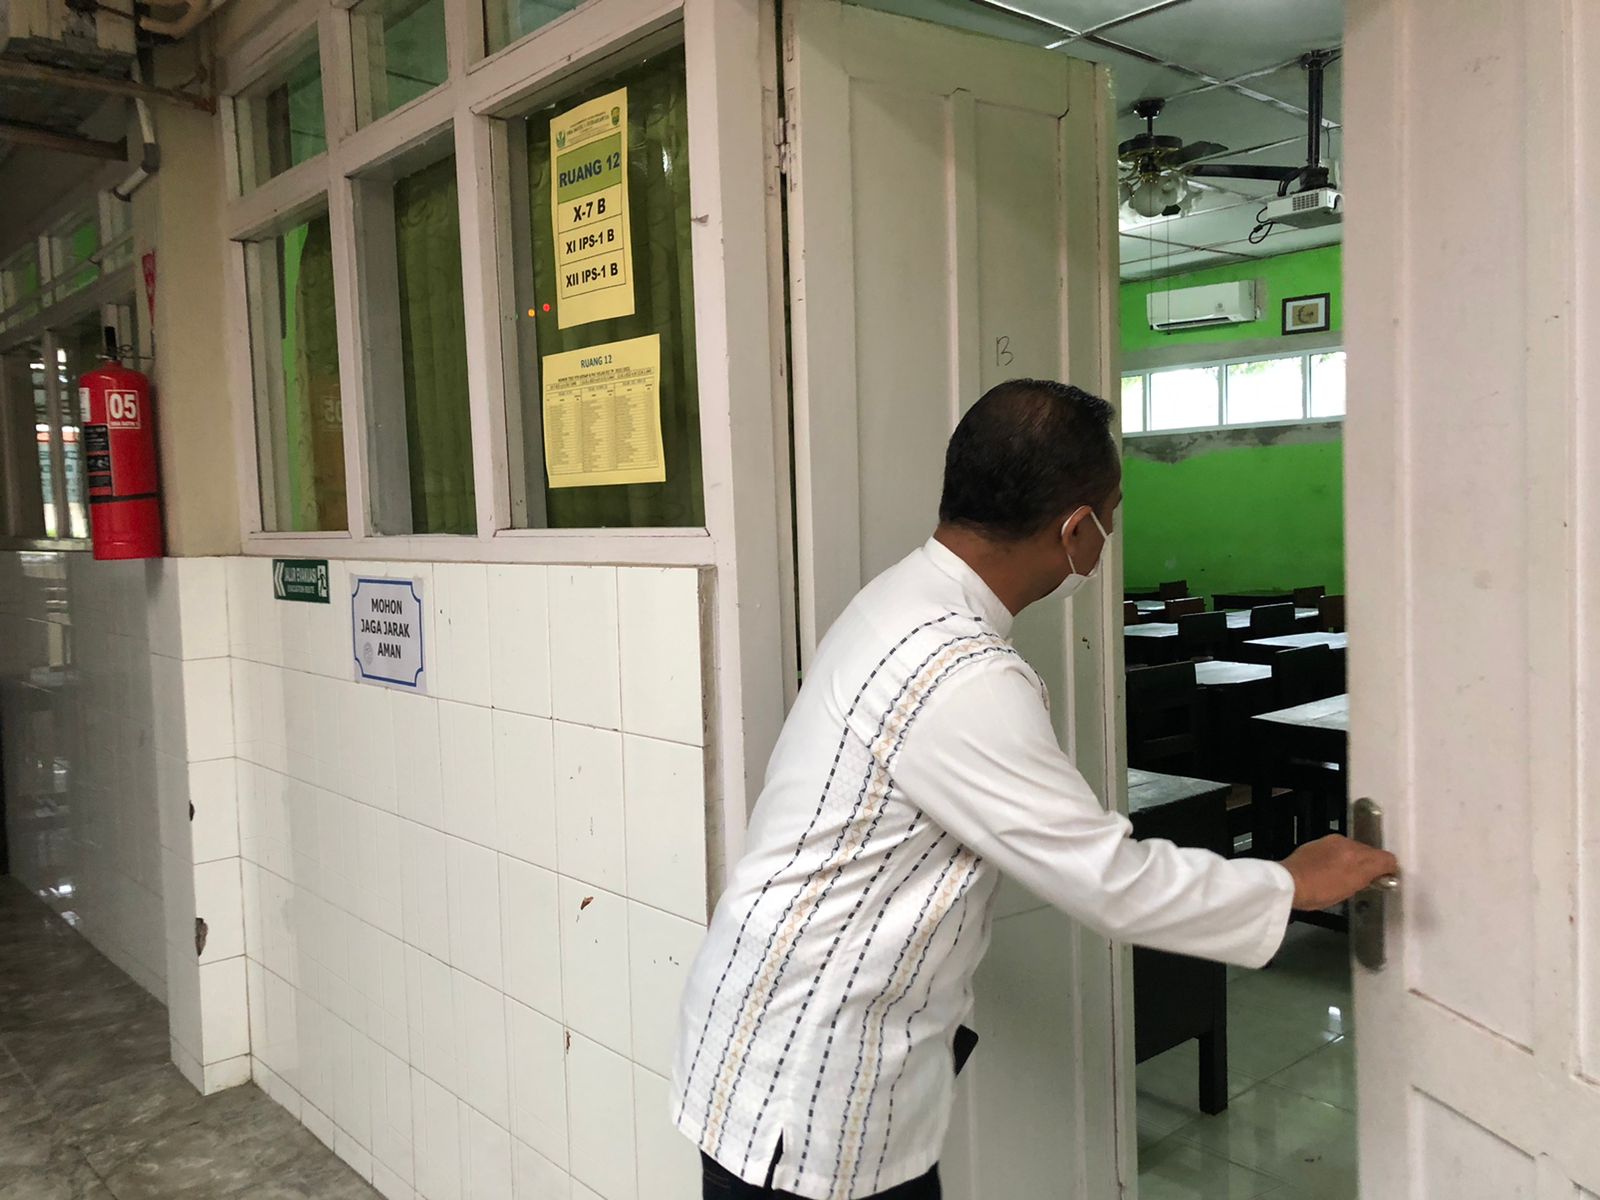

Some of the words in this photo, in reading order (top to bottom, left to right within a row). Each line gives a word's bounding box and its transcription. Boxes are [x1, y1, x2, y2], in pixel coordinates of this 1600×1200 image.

[559, 158, 603, 188] RUANG
[606, 151, 620, 172] 12
[573, 201, 594, 223] X-7
[597, 197, 606, 215] B
[566, 239, 576, 255] XI
[579, 231, 604, 251] IPS-1
[607, 228, 615, 243] B
[566, 271, 579, 288] XII
[581, 265, 606, 284] IPS-1
[610, 262, 618, 277] B
[580, 355, 603, 368] RUANG
[604, 354, 612, 364] 12
[110, 393, 136, 419] 05
[371, 598, 402, 615] MOHON
[361, 619, 382, 634] JAGA
[383, 620, 410, 638] JARAK
[377, 642, 401, 659] AMAN
